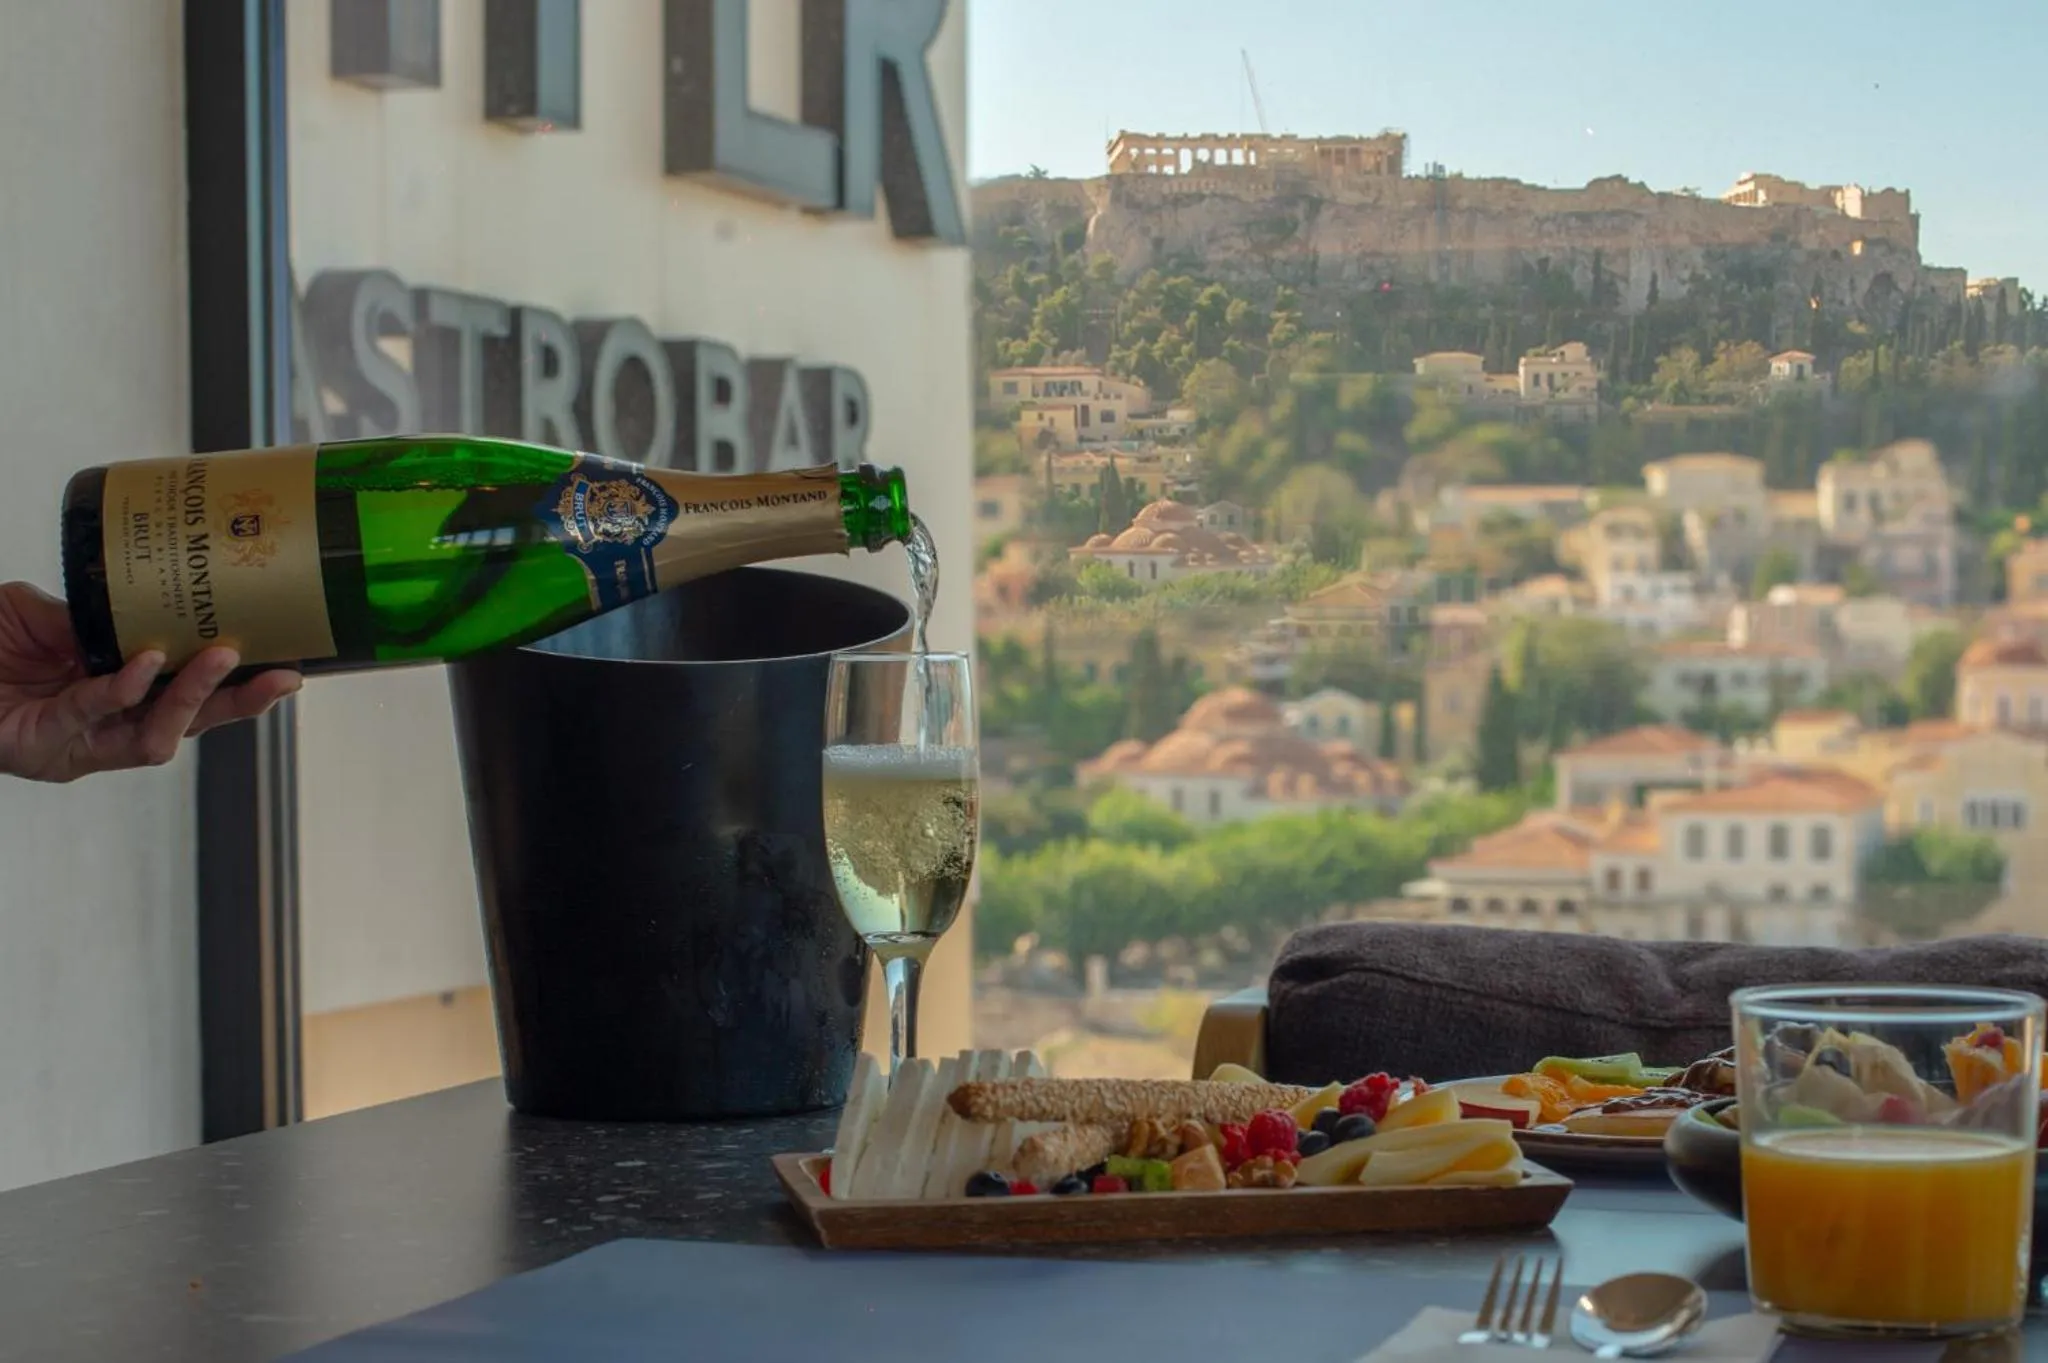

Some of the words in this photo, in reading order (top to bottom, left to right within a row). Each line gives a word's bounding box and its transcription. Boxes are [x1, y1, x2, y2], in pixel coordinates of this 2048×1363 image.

[574, 492, 587, 530] BRUT
[756, 490, 828, 508] MONTAND
[133, 513, 151, 563] BRUT
[186, 533, 219, 639] MONTAND
